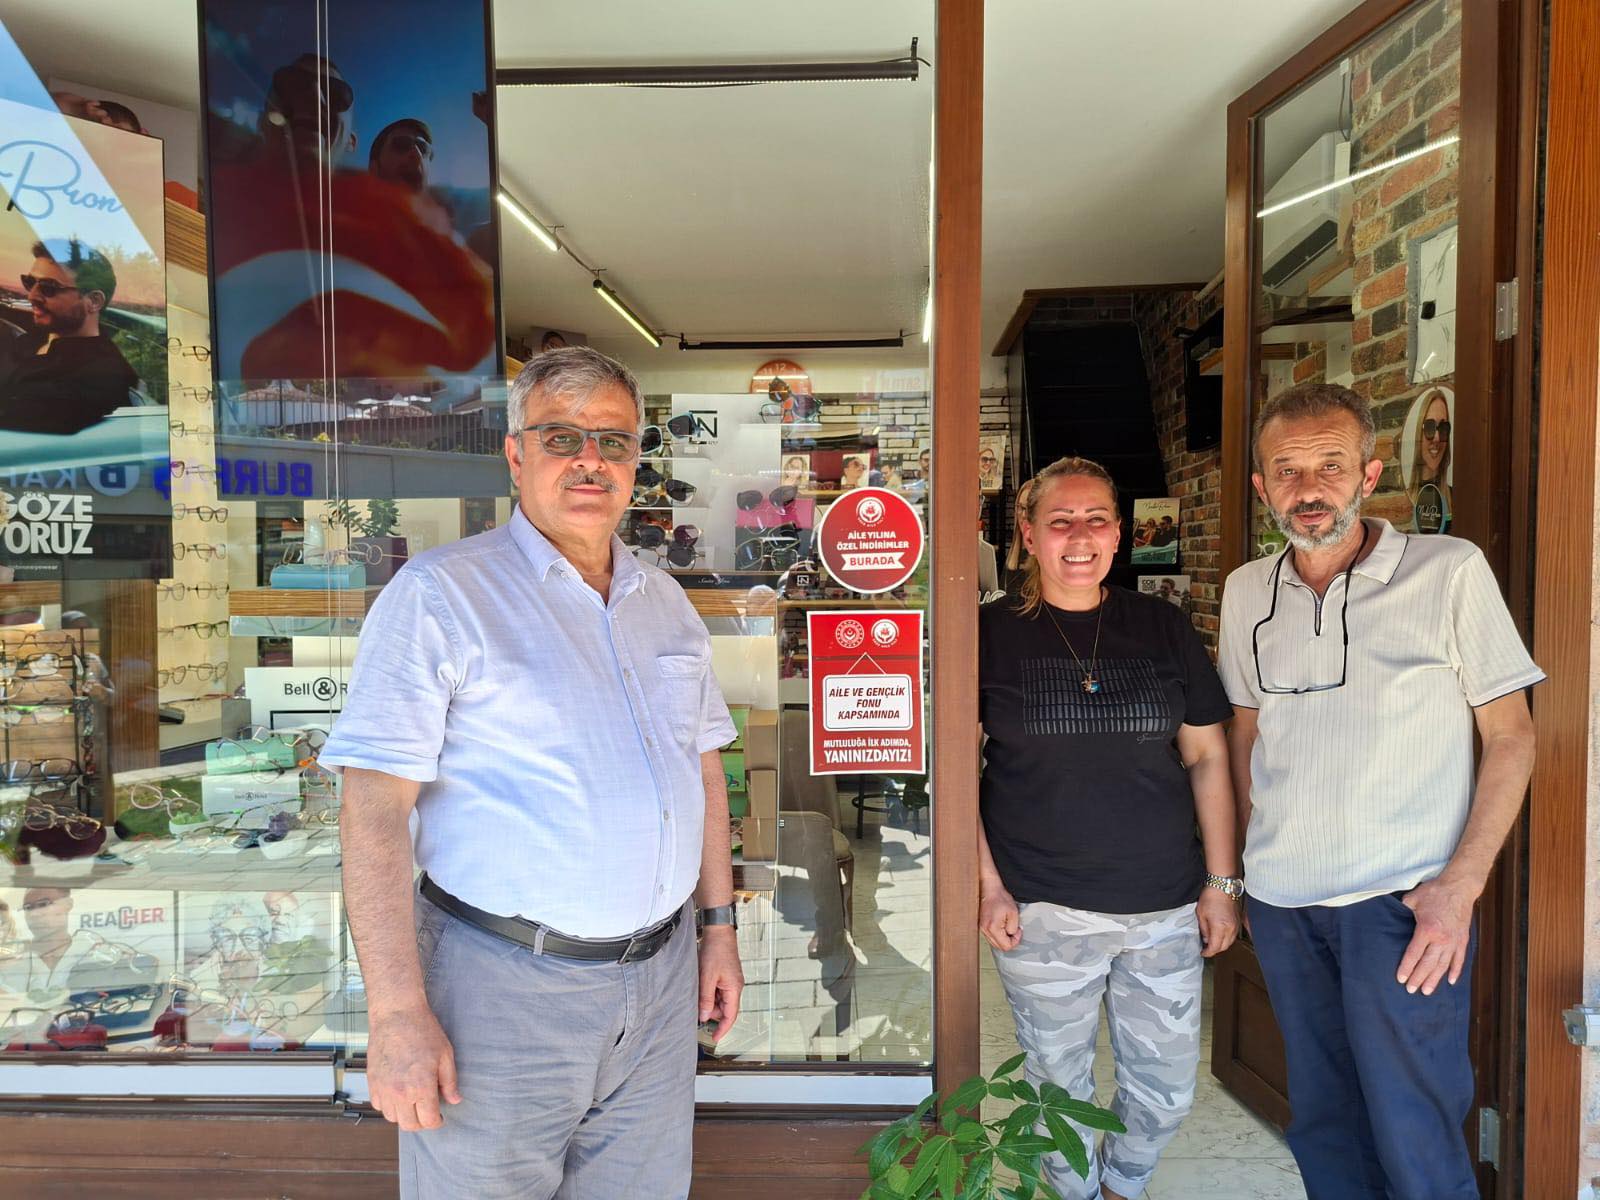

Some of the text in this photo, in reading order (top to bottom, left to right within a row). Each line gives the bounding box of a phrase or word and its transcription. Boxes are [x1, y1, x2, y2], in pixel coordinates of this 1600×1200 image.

[0, 521, 94, 555] ORUZ
[848, 530, 897, 540] AİLE YILINA
[836, 540, 910, 551] ÖZEL İNDİRİMLER
[849, 556, 896, 566] BURADA
[284, 683, 310, 695] Bell
[829, 685, 906, 698] AİLE VE GENÇLİK
[856, 699, 882, 708] FONU
[837, 710, 900, 720] KAPSAMINDA
[823, 737, 912, 748] MUTLULUĞA İLK ADIMDA,
[823, 749, 912, 764] YANINIZDAYIZ!
